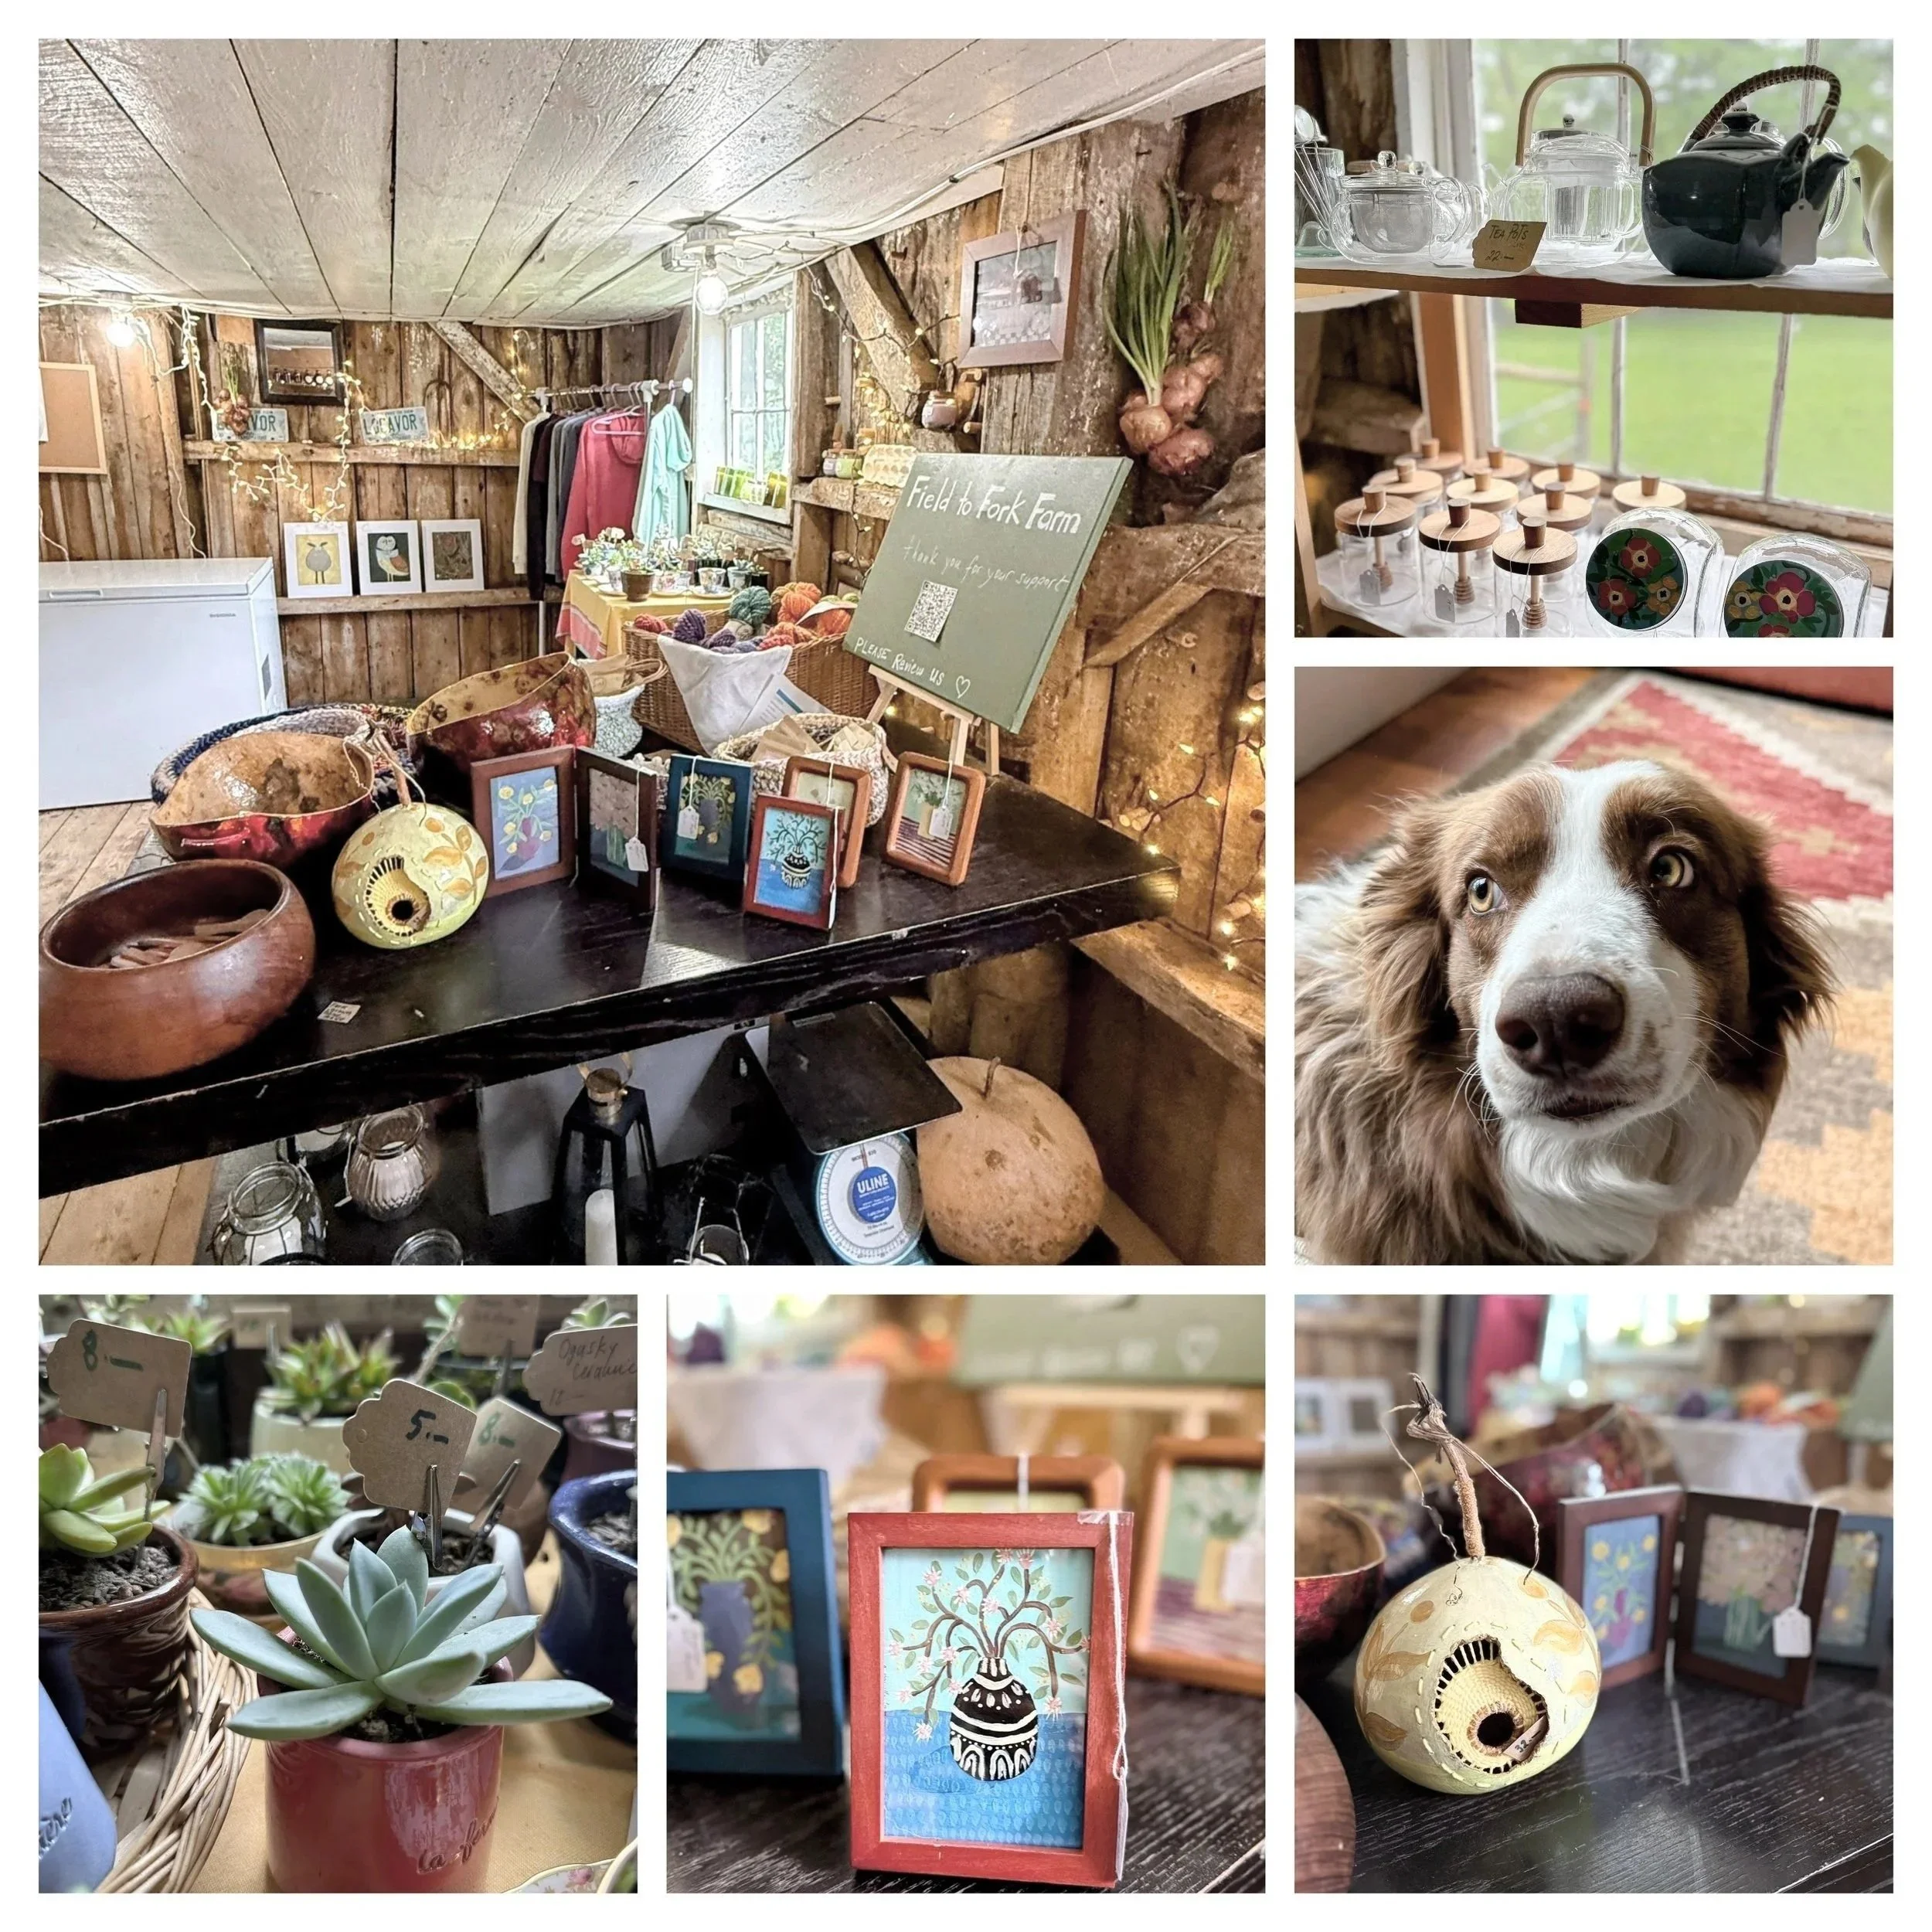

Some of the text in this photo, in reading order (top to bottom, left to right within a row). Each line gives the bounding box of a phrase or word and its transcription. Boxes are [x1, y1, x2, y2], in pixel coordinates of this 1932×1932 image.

[1489, 223, 1529, 241] TEA POTS
[216, 414, 277, 431] LVOR
[362, 413, 417, 435] LOCAVOR
[906, 474, 1082, 534] Field to Fork Farm
[941, 556, 962, 575] you
[960, 554, 983, 583] for
[977, 568, 1015, 588] your
[1015, 573, 1070, 592] support
[853, 637, 891, 660] PLEASE
[891, 653, 925, 676] Review
[857, 1173, 889, 1193] ULINE
